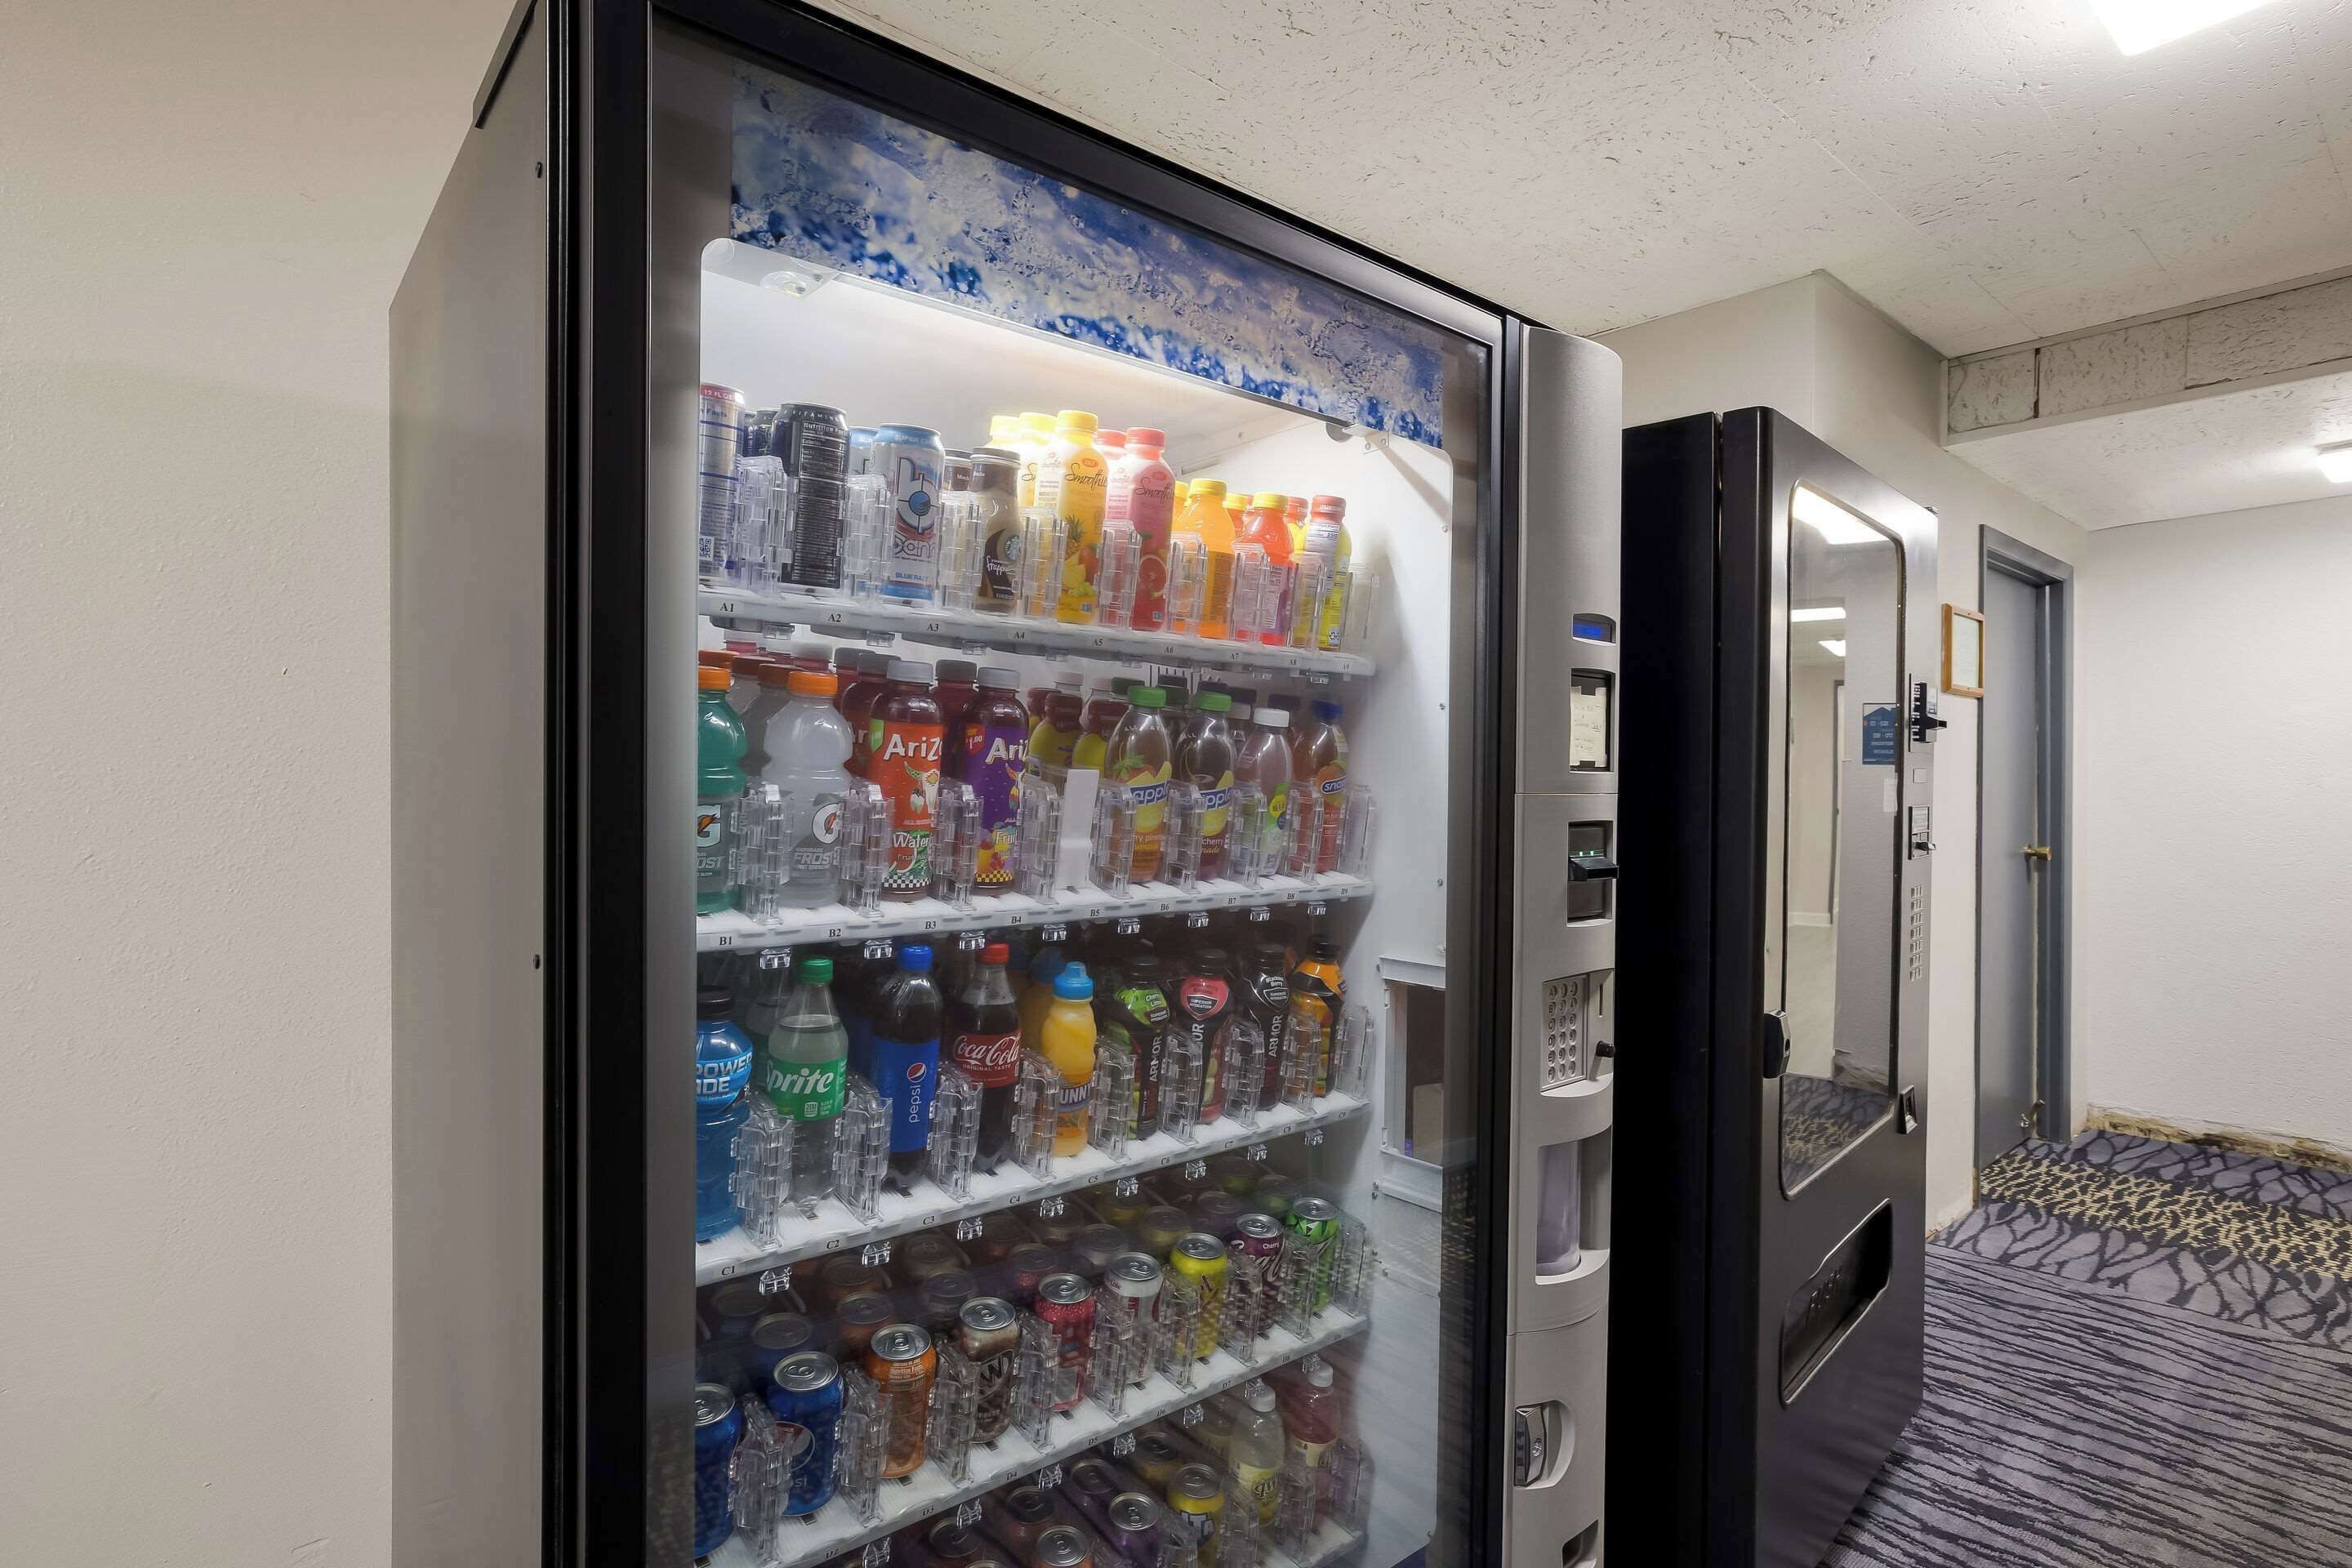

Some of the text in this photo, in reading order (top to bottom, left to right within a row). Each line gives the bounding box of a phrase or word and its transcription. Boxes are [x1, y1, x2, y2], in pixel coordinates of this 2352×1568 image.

[719, 602, 733, 612] A1
[828, 613, 841, 622] A2
[927, 623, 939, 632] A3
[1013, 632, 1026, 640] A4
[1092, 639, 1103, 647] A5
[1164, 646, 1174, 654] A6
[883, 733, 942, 761] AriZ
[697, 857, 726, 870] OST
[1160, 903, 1169, 911] B6
[1090, 909, 1100, 917] B5
[1011, 915, 1022, 924] B4
[924, 920, 936, 929] B3
[829, 929, 841, 938] B2
[719, 936, 732, 946] B1
[962, 1063, 993, 1071] ORIGINAL
[1059, 1082, 1092, 1104] UNNY
[908, 1084, 922, 1124] pepsi
[1160, 1156, 1170, 1165] C6
[1088, 1175, 1098, 1183] C5
[1009, 1195, 1021, 1204] C4
[923, 1215, 935, 1225] C3
[826, 1240, 840, 1250] C2
[721, 1265, 735, 1276] C1
[1088, 1437, 1098, 1445] D5
